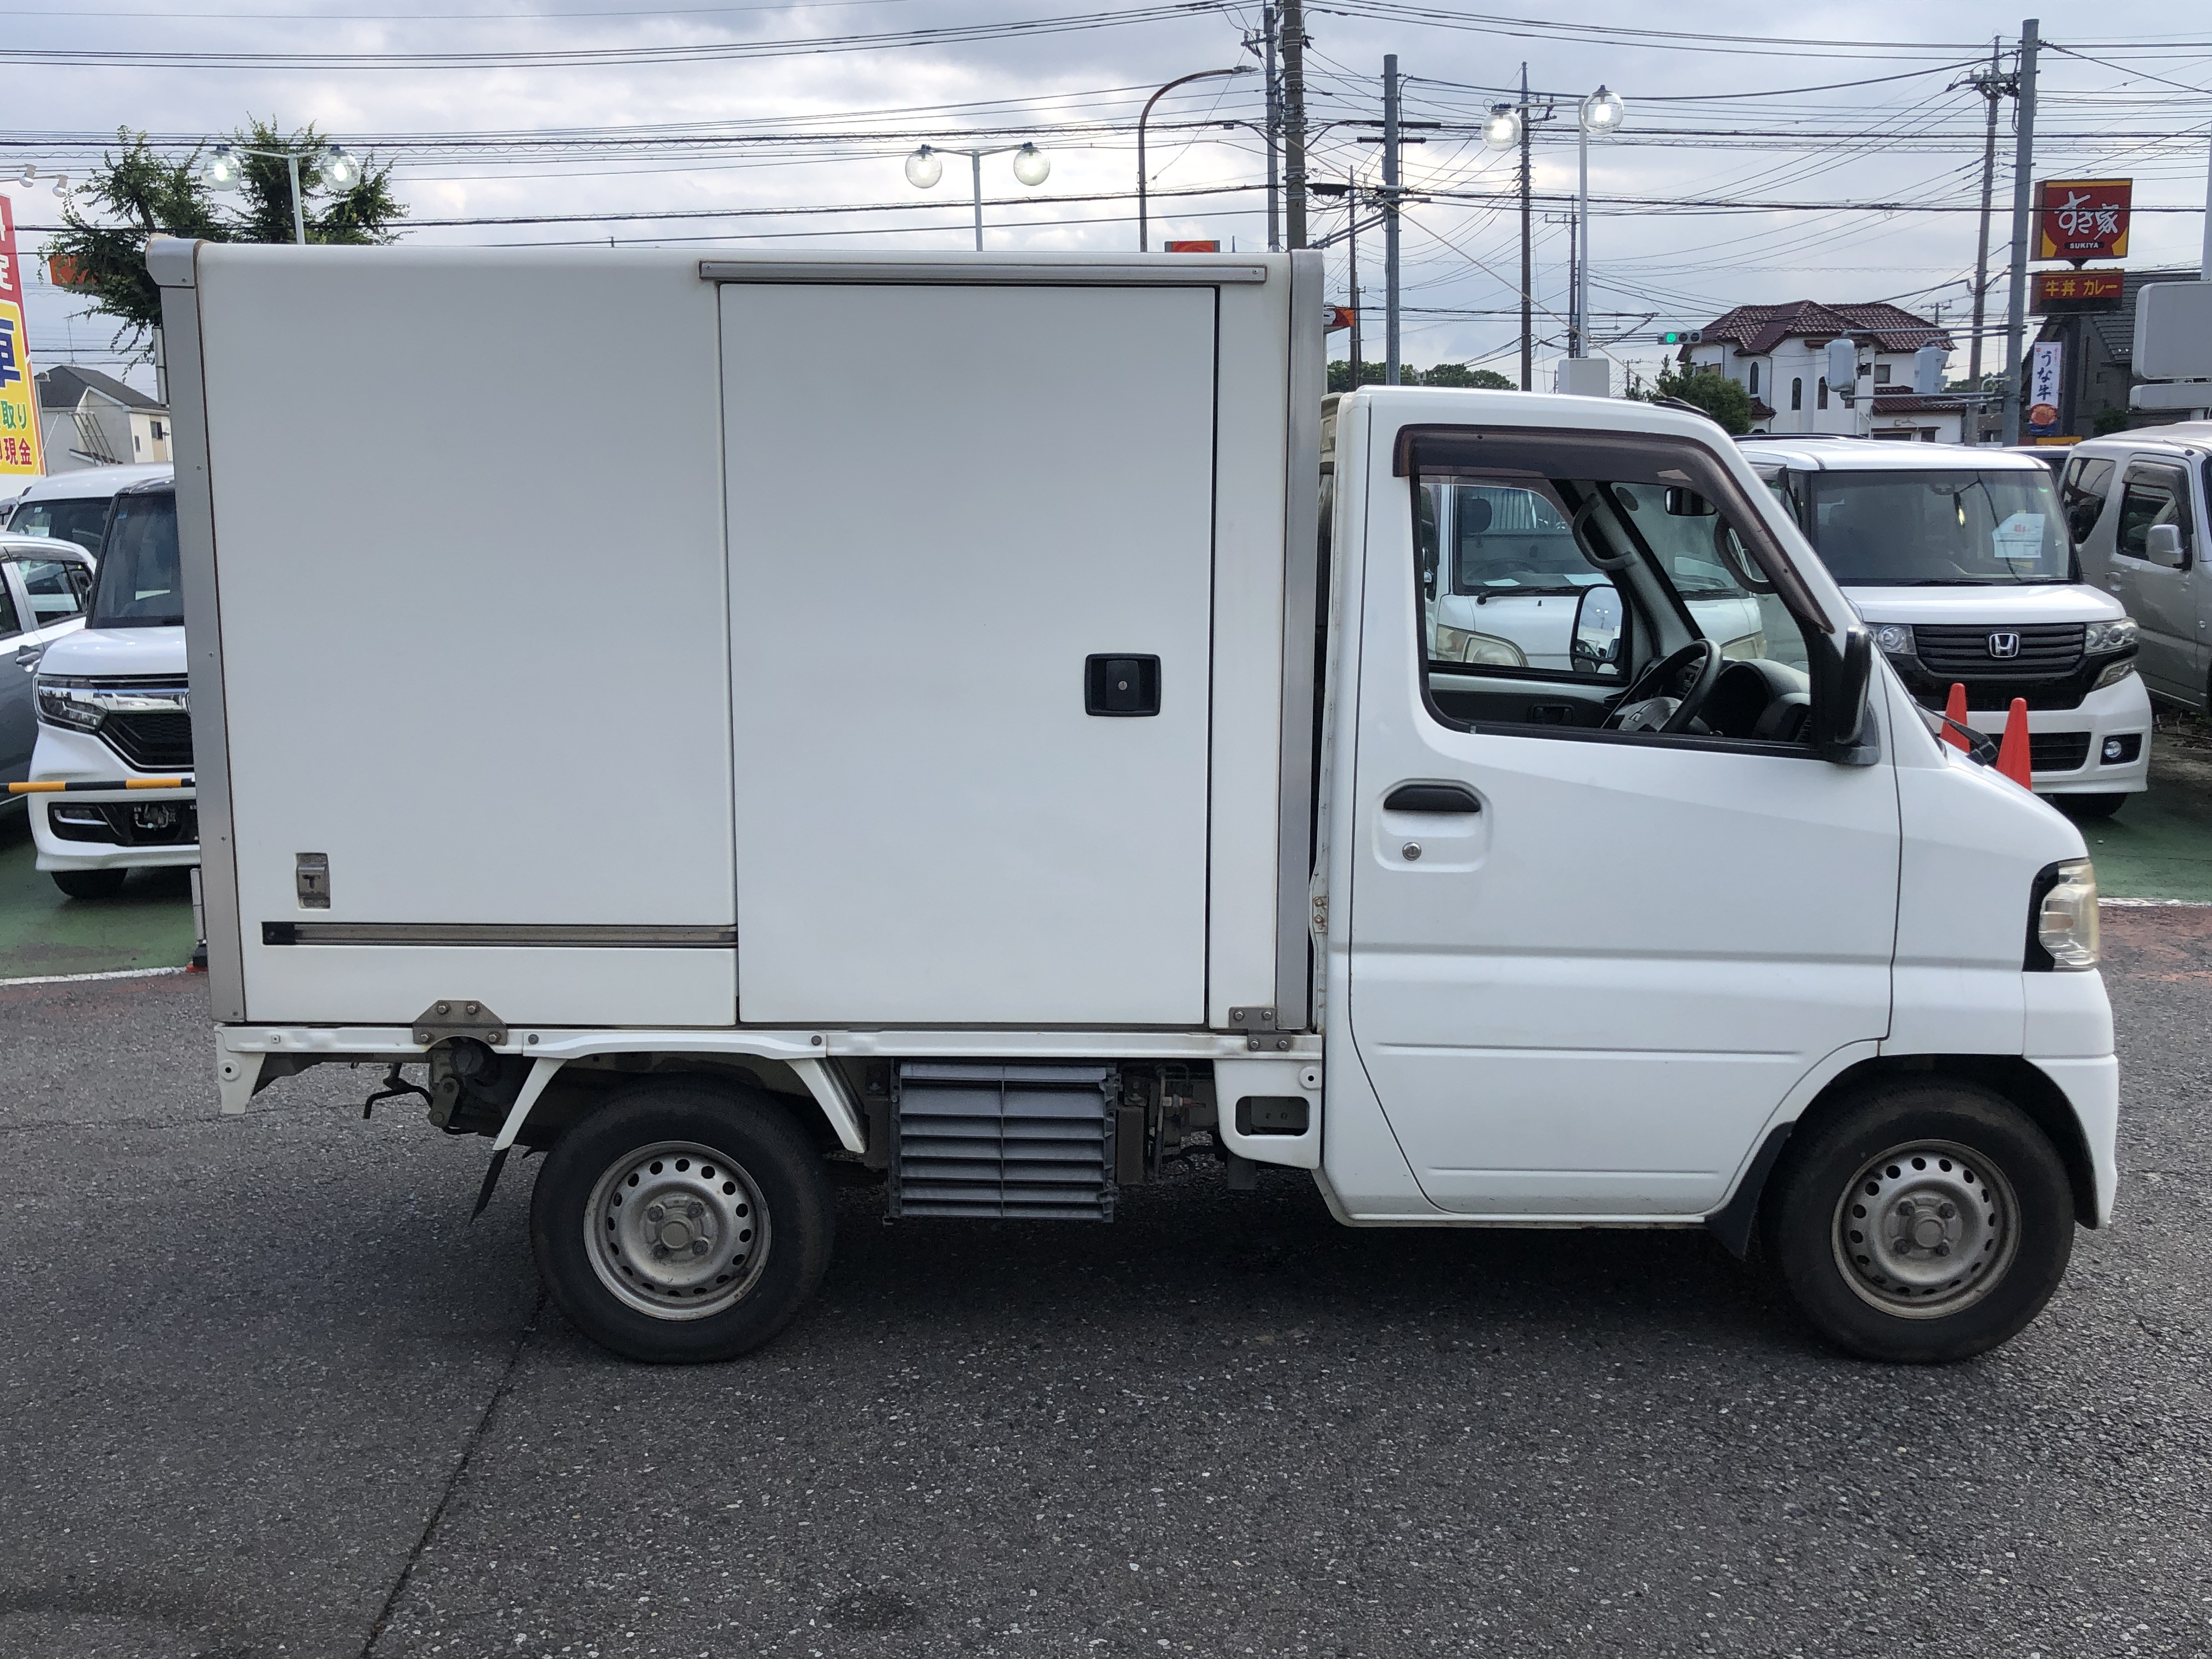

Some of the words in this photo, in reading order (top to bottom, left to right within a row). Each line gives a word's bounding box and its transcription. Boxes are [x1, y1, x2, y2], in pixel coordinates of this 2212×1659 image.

[2054, 191, 2119, 240] すき家
[2045, 280, 2076, 297] 牛丼
[2083, 279, 2118, 296] カレー
[2036, 350, 2053, 401] うな牛
[0, 400, 27, 430] 取り
[0, 437, 32, 465] 現金
